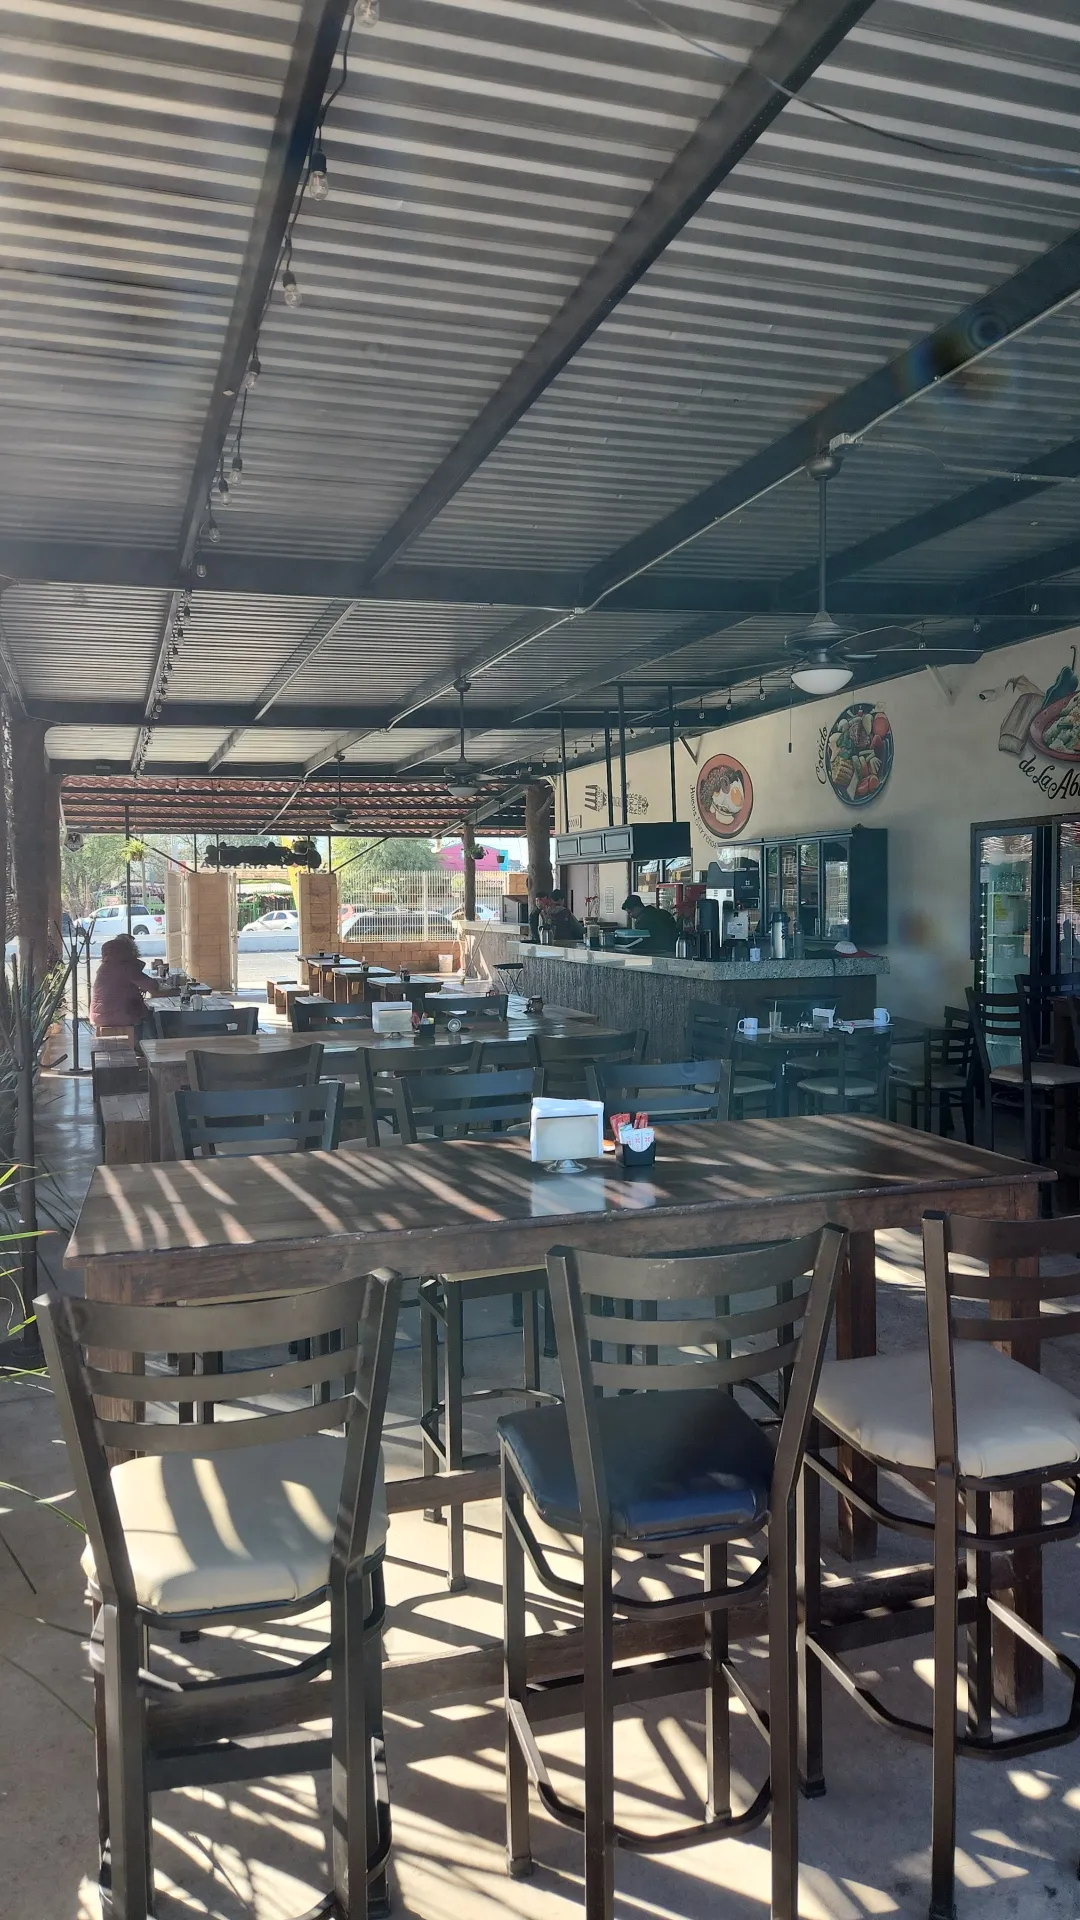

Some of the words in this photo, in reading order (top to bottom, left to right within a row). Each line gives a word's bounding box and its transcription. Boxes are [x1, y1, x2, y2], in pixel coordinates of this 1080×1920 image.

[815, 723, 828, 785] Cocido
[1018, 753, 1036, 778] de
[1031, 765, 1056, 793] La
